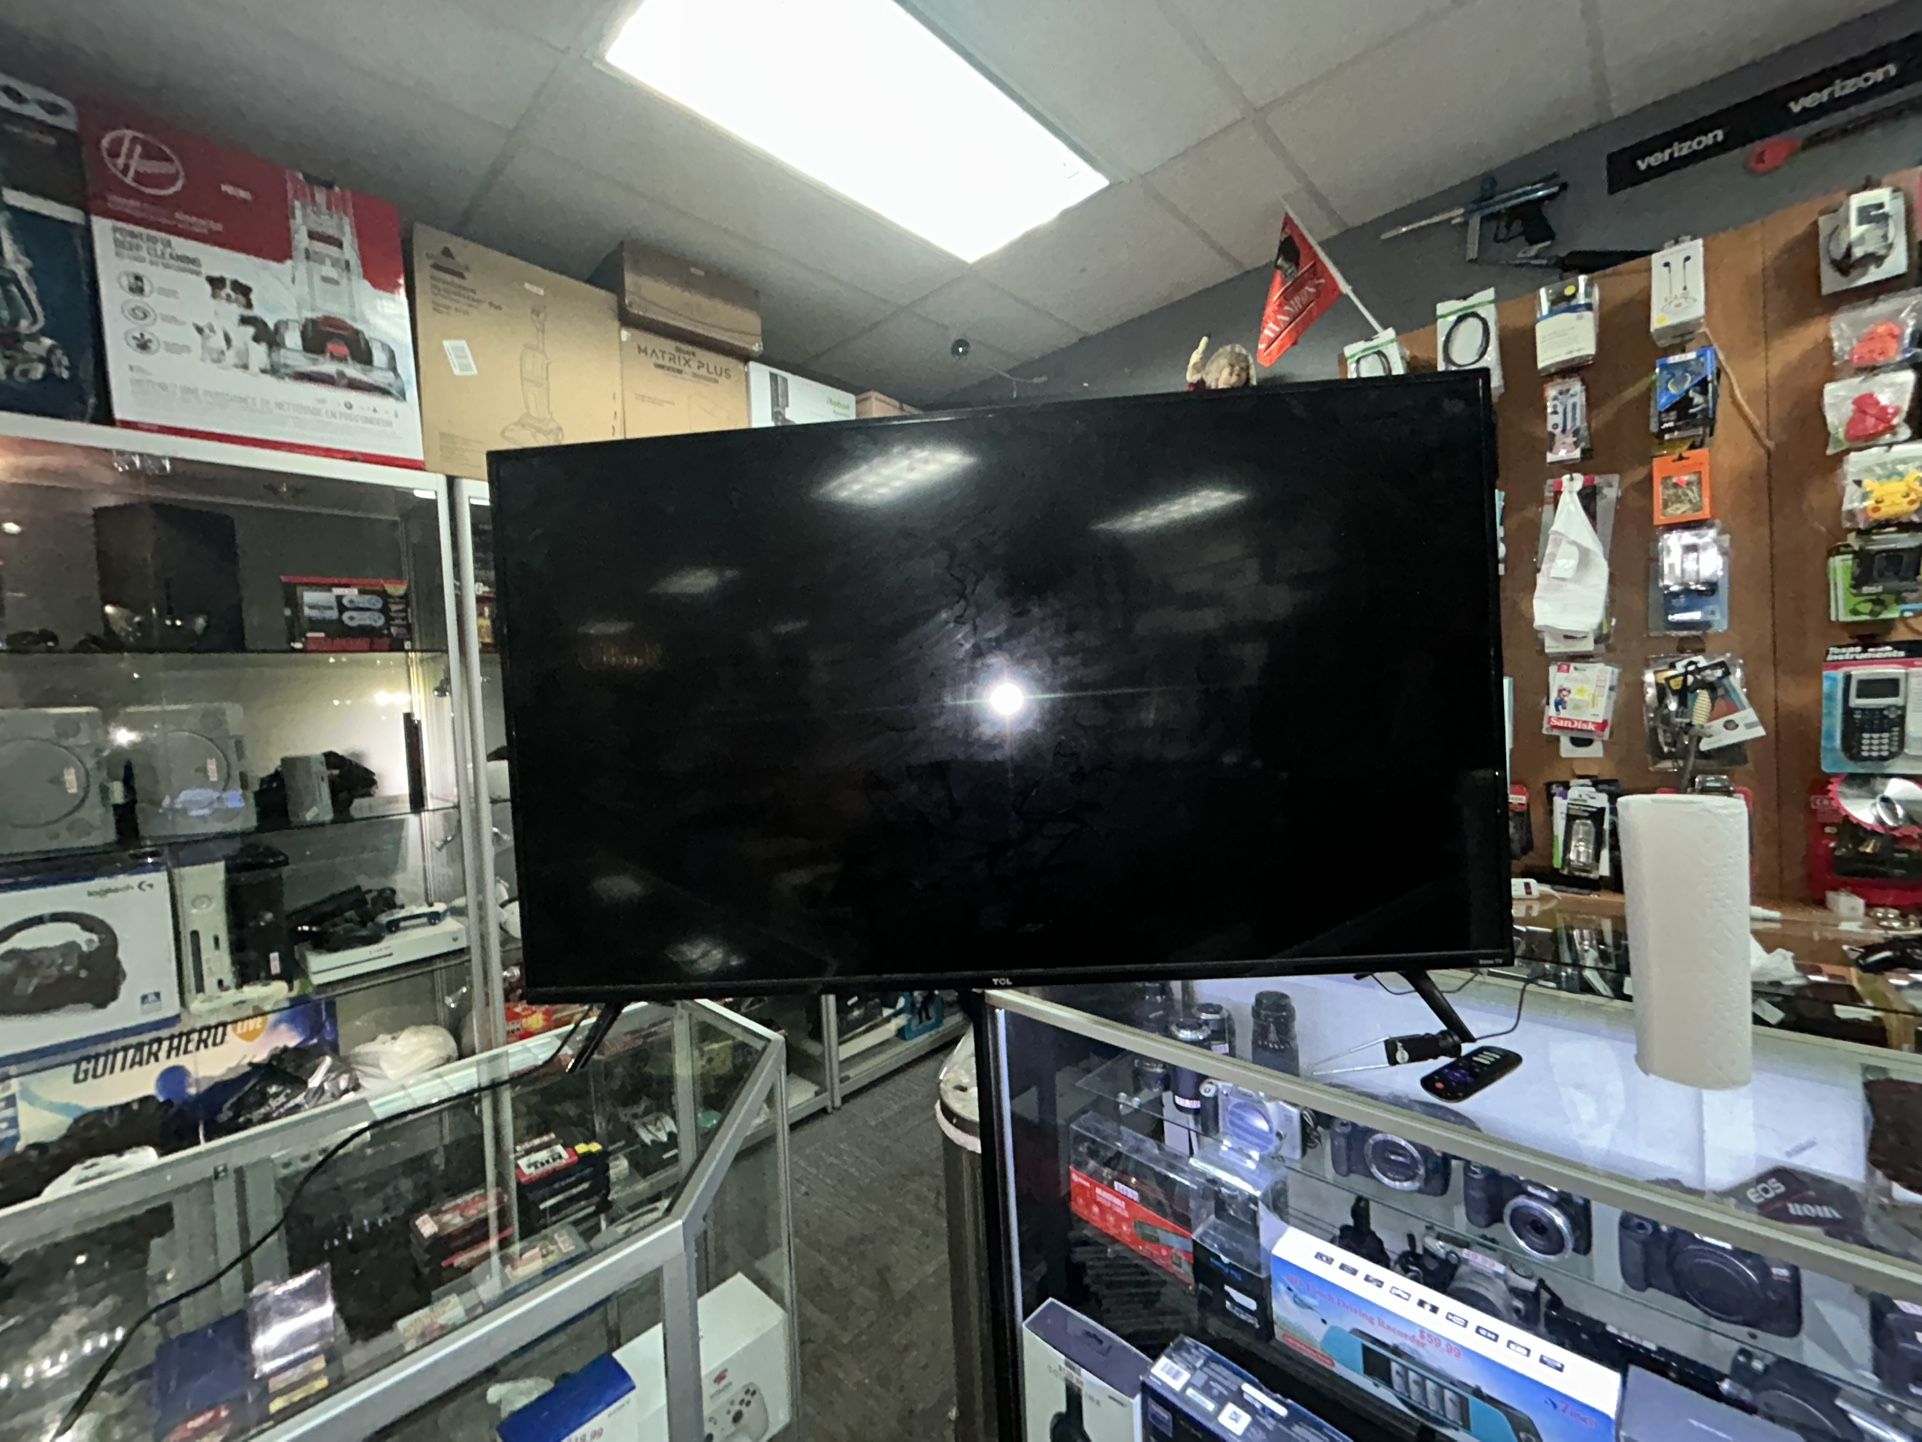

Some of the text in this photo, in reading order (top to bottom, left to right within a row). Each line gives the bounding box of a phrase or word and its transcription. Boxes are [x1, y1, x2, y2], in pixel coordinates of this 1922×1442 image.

[1788, 63, 1897, 113] verizon
[1636, 128, 1725, 171] verizon
[637, 344, 692, 369] MATRIX
[697, 360, 732, 380] PLUS
[1827, 650, 1905, 661] Instruments
[1828, 646, 1862, 655] Texas
[1549, 717, 1596, 731] SanDisk
[992, 977, 1013, 986] TCL
[73, 1016, 263, 1084] GUITAR HERO LIVE
[1746, 1177, 1787, 1204] EOS
[1418, 1328, 1463, 1359] $59.99
